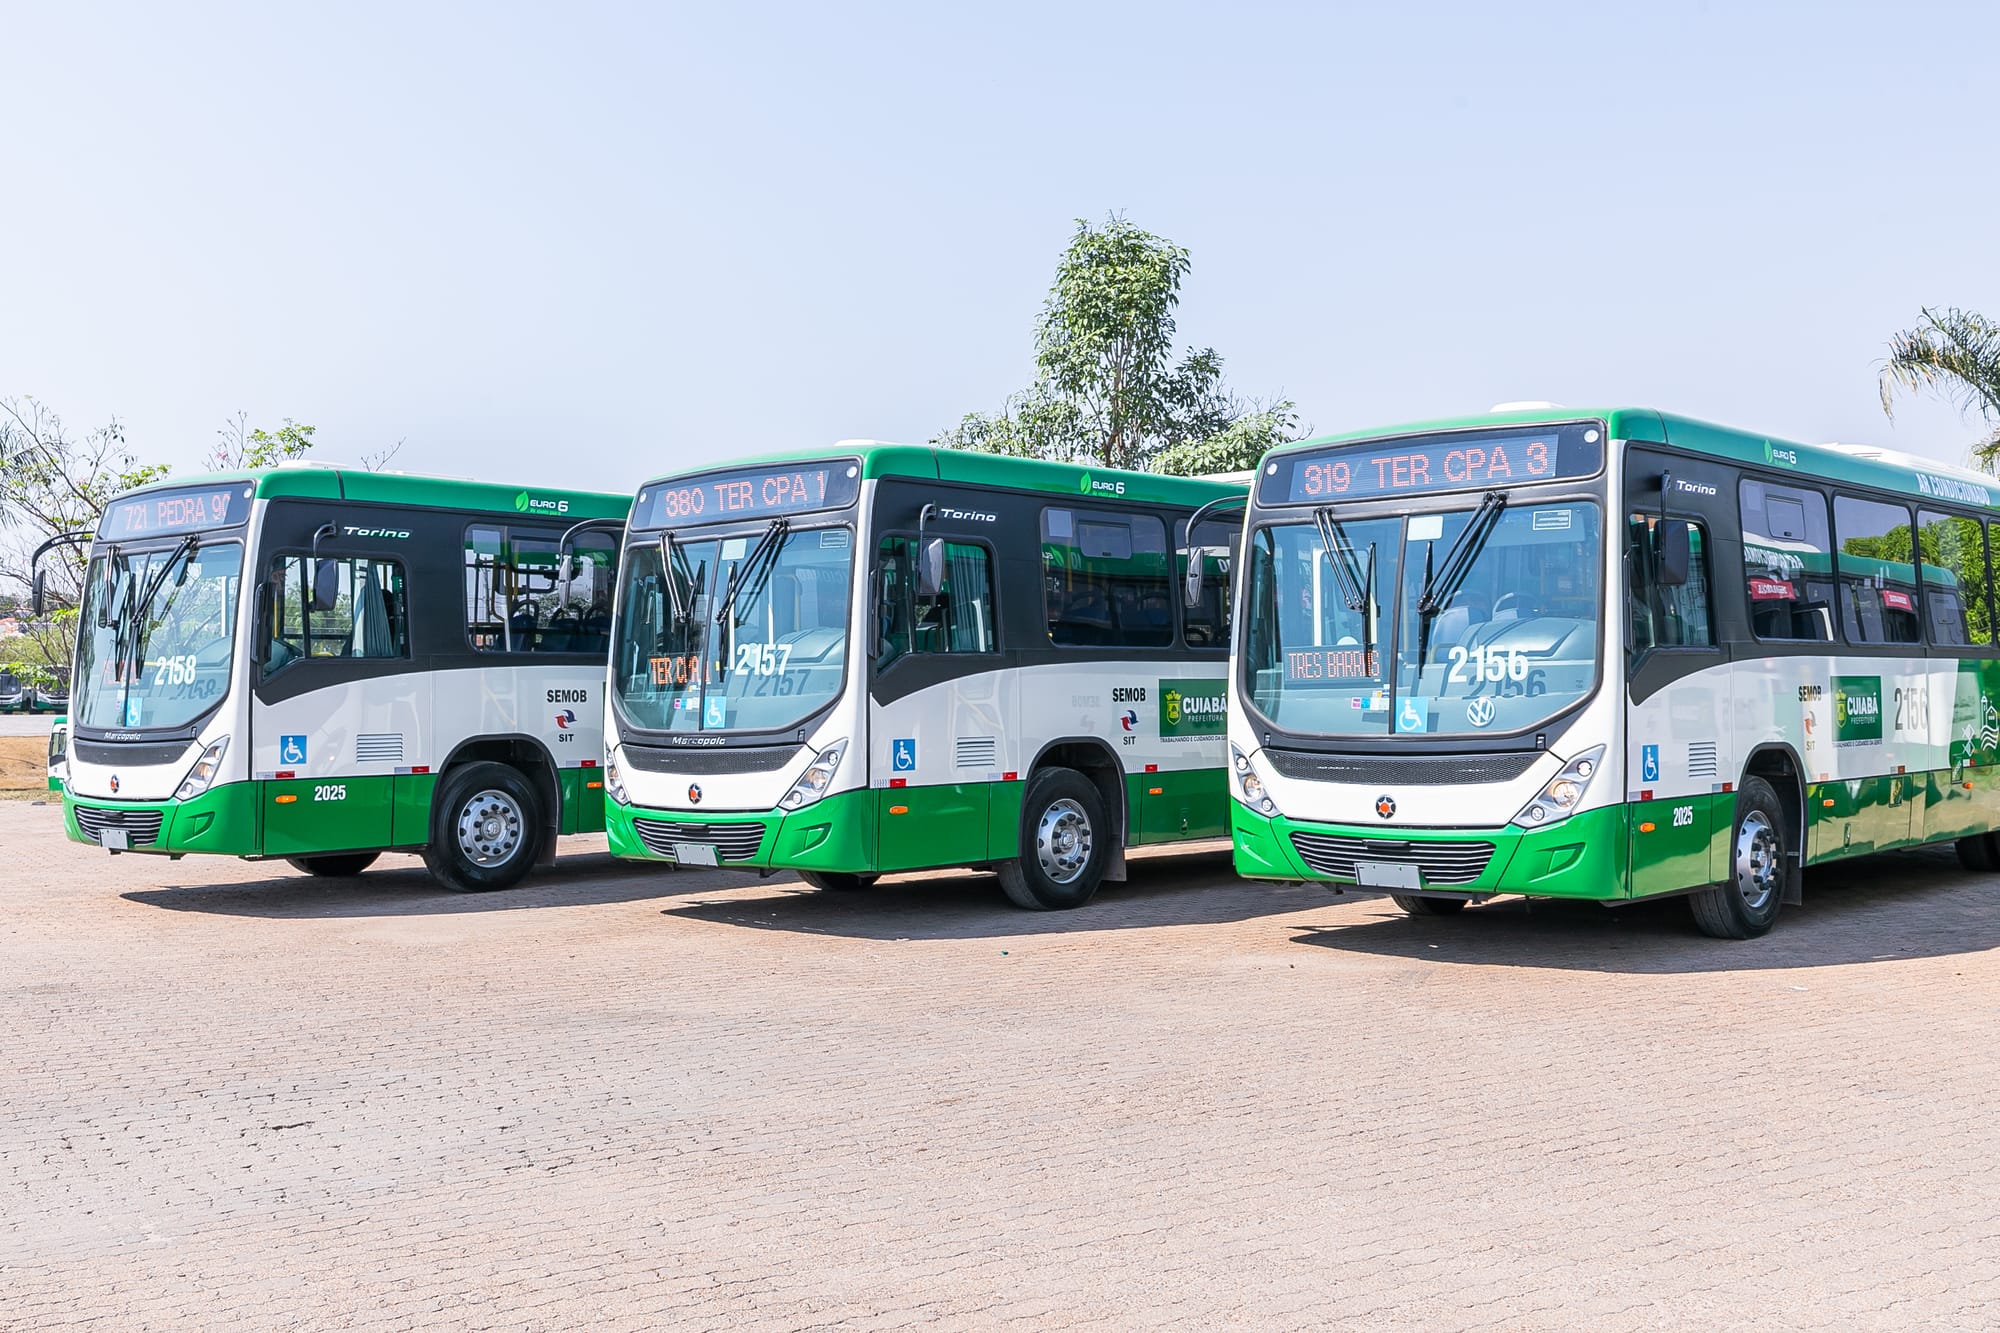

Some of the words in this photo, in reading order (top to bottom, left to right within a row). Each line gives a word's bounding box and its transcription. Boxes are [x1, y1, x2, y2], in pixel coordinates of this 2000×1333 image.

[1789, 450, 1797, 465] 6
[1304, 462, 1350, 495] 319
[1371, 454, 1431, 489] TER
[1443, 446, 1512, 482] CPA
[1526, 441, 1548, 475] 3
[665, 488, 704, 518] 380
[714, 481, 753, 511] TER
[761, 475, 808, 506] CPA
[816, 471, 825, 500] 1
[1092, 481, 1115, 491] EURO
[1115, 482, 1125, 494] 6
[1676, 480, 1717, 495] Torino
[124, 503, 147, 531] 721
[157, 496, 207, 528] PEDRA
[530, 499, 556, 509] EURO
[557, 500, 569, 512] 6
[940, 508, 997, 522] Torino
[343, 526, 411, 539] Torino
[735, 643, 793, 676] 2157
[1288, 652, 1322, 678] TRES
[1448, 645, 1529, 683] 2156
[153, 654, 197, 686] 2158
[649, 657, 673, 685] TER
[546, 689, 588, 703] SEMOB
[1112, 687, 1146, 702] SEMOB
[1183, 692, 1228, 714] CUIABÁ
[1798, 685, 1822, 702] SEMOB
[1847, 692, 1879, 715] CUIABÁ
[1895, 688, 1929, 731] 2156
[558, 733, 575, 743] SIT
[1123, 736, 1136, 745] SIT
[314, 784, 346, 801] 2025
[1673, 805, 1693, 827] 2025
